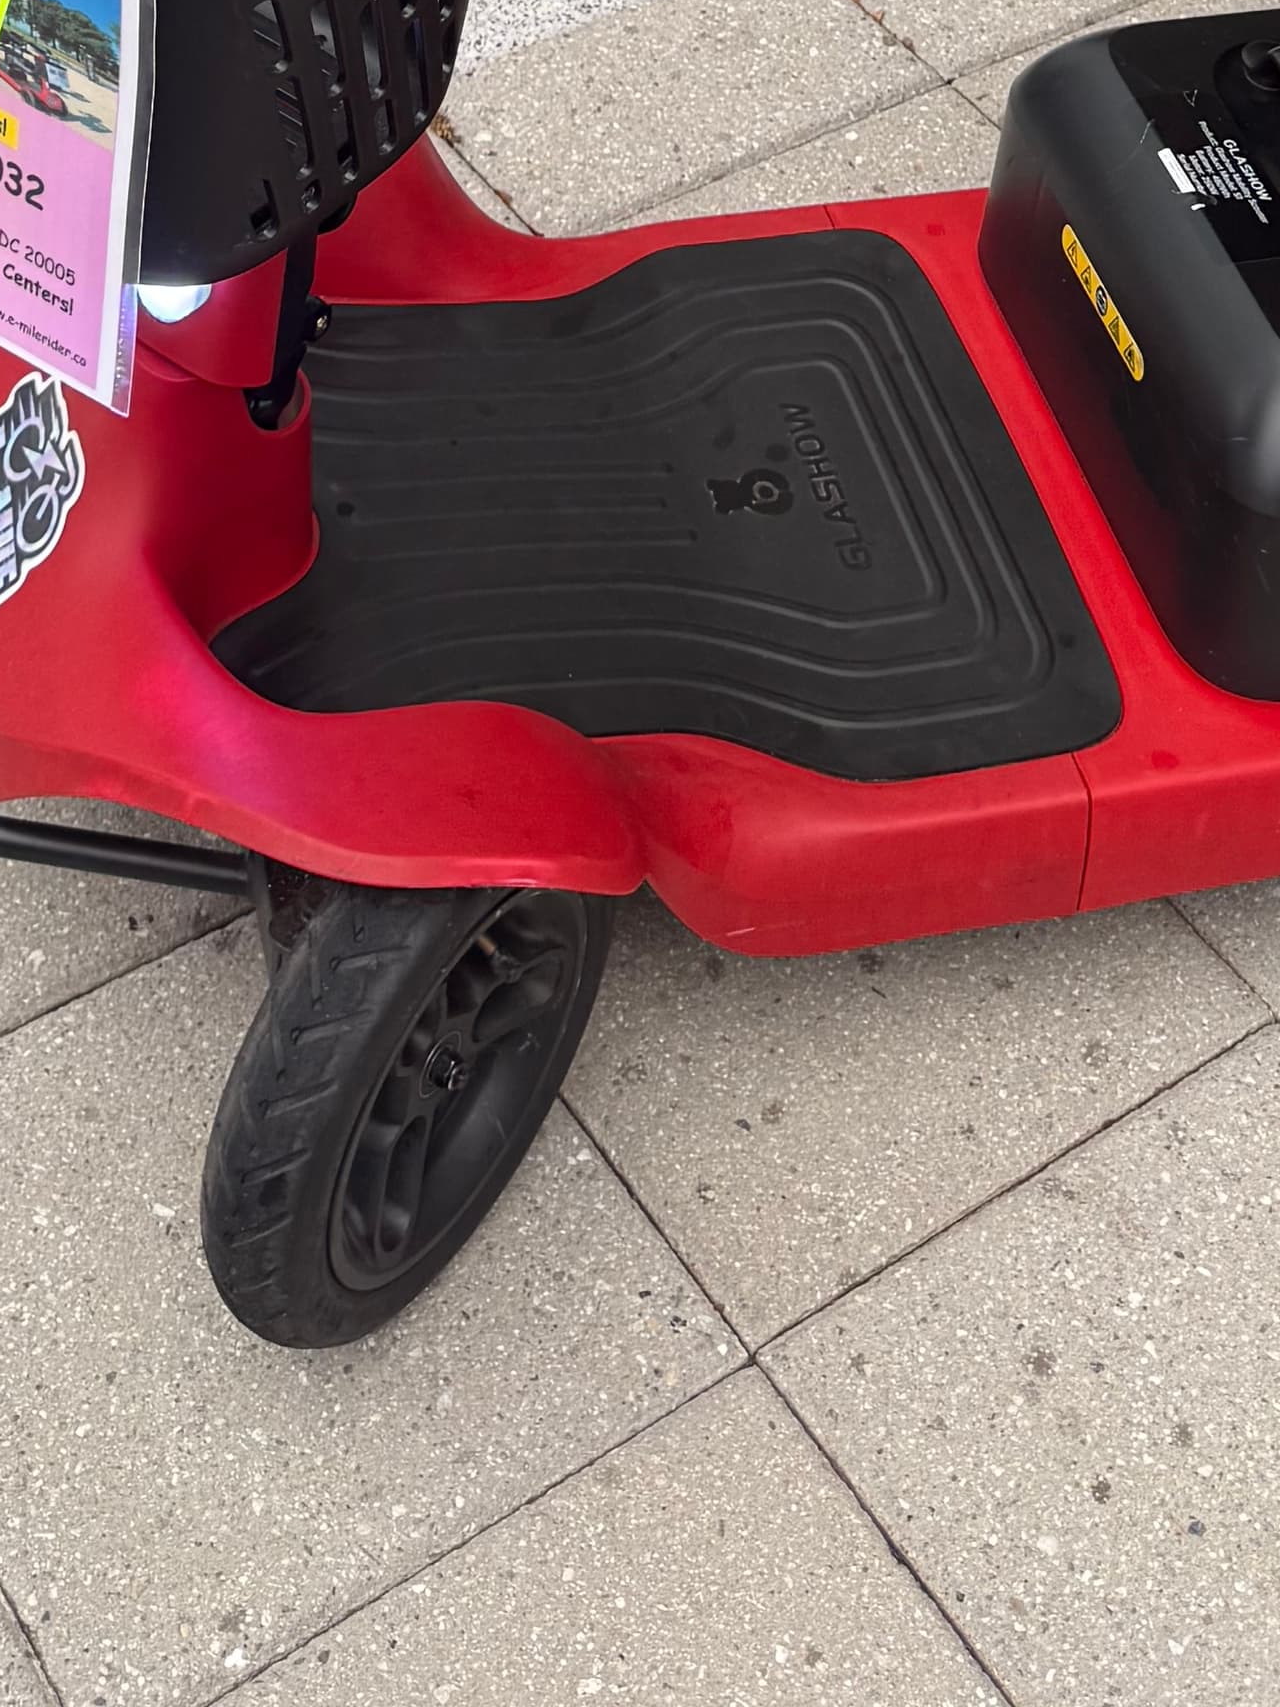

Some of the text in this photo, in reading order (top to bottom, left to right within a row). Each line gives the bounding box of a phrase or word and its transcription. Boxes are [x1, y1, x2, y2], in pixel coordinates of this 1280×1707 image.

[1223, 139, 1272, 201] GLASHOW
[2, 263, 74, 316] Centers!
[24, 244, 76, 287] 20005
[779, 403, 872, 571] GLASHOW
